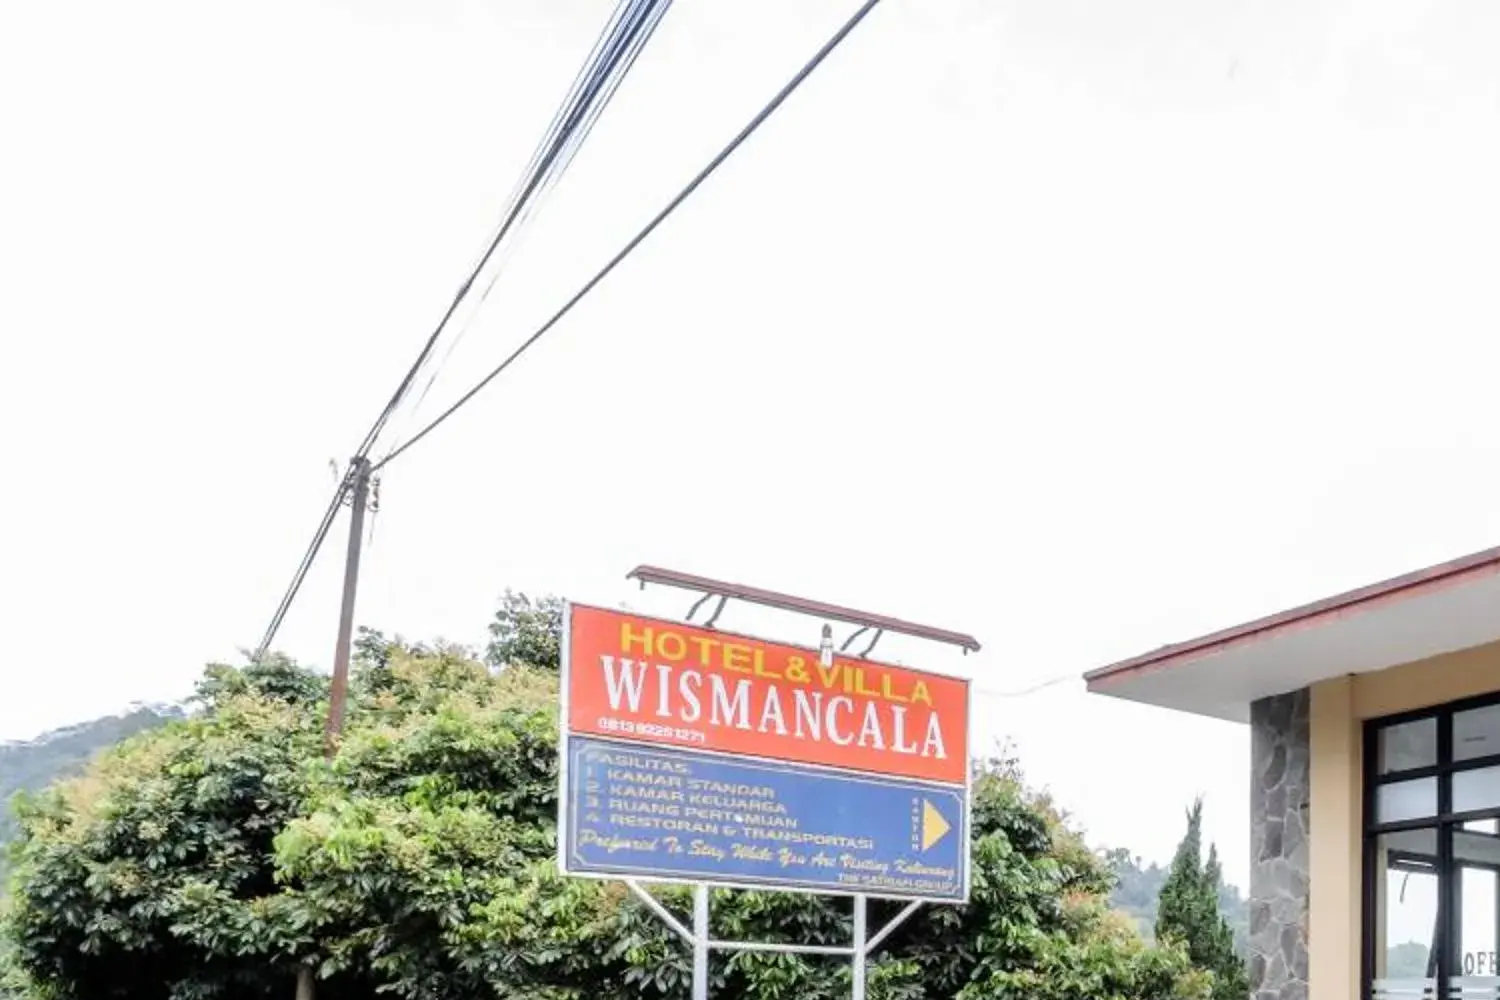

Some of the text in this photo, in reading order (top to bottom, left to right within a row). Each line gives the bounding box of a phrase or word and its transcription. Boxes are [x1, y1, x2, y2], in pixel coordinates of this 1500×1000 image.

[600, 655, 947, 759] WISMANCALA
[608, 769, 681, 787] KAMAR
[687, 778, 775, 799] STANDAR
[610, 783, 684, 801] KAMAR
[690, 795, 787, 814] KELUARGA
[609, 799, 680, 817] RUANG
[609, 814, 718, 834] RESTORAN
[743, 826, 873, 850] TRANSPORTASI
